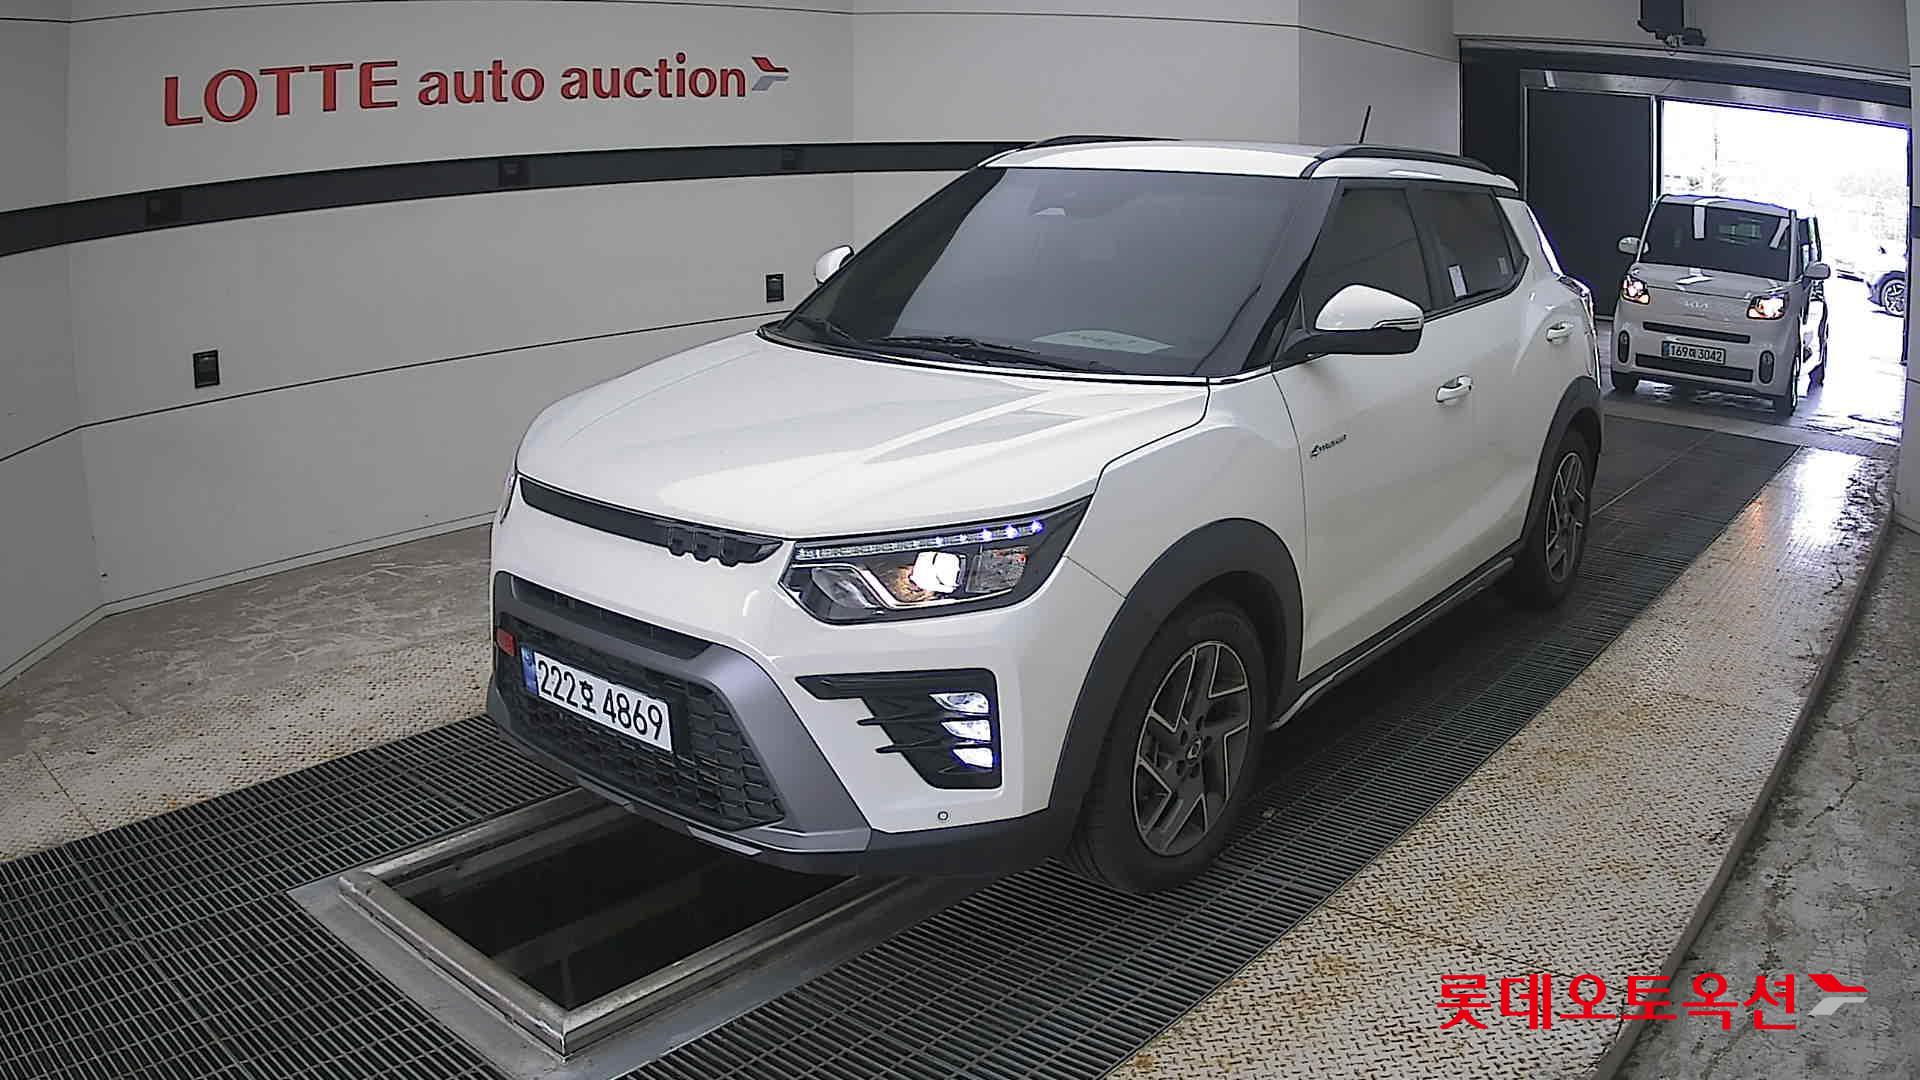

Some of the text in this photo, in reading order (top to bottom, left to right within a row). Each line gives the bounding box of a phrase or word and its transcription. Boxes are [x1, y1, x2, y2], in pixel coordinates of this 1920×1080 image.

[163, 52, 747, 126] LOTTE auto auction
[1697, 348, 1722, 362] 3042
[538, 660, 663, 740] 222호 4869
